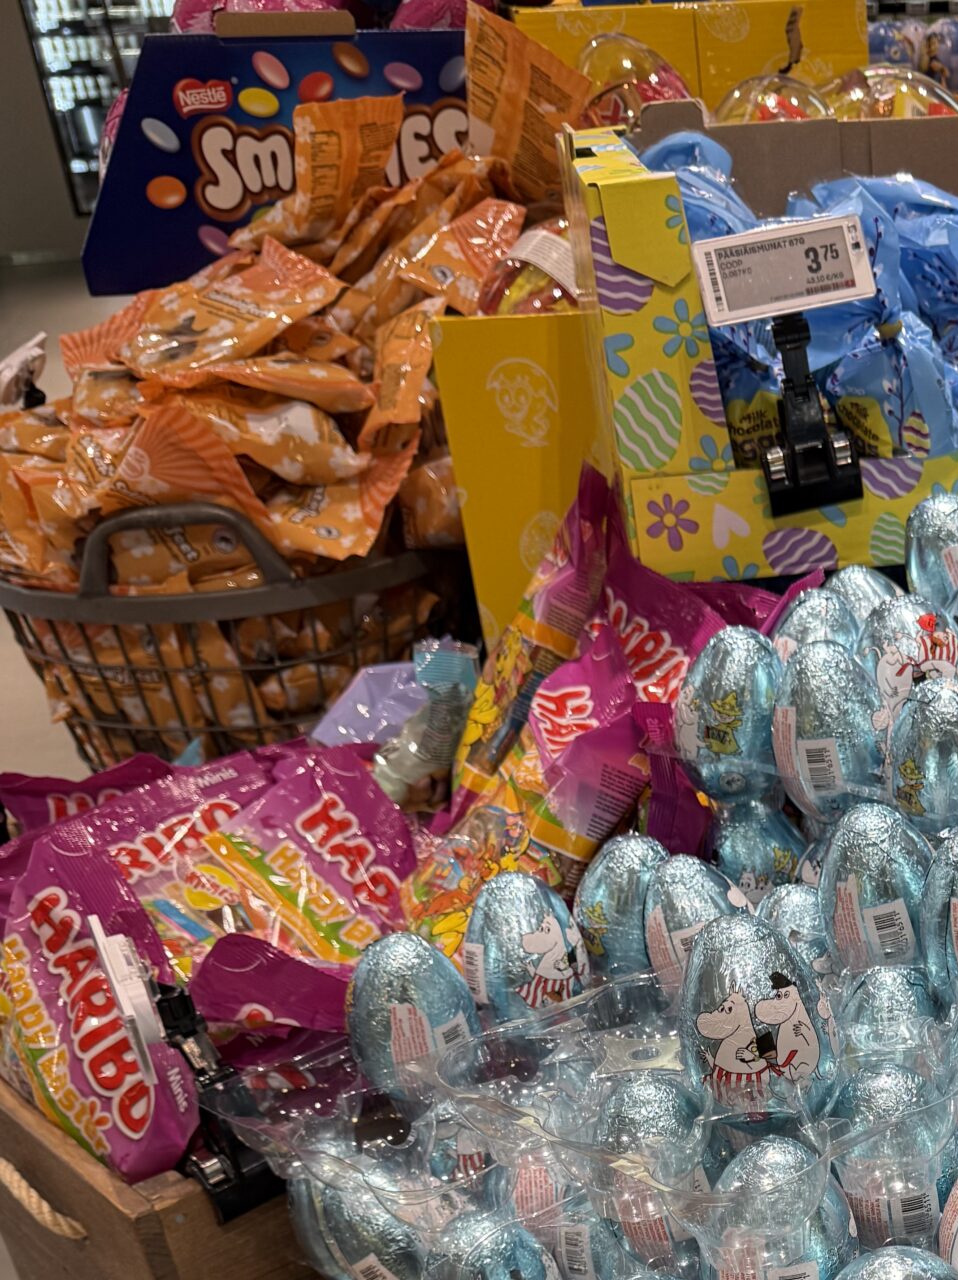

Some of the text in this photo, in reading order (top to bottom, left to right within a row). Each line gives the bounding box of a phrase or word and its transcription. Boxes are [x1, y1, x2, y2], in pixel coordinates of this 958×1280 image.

[720, 259, 743, 271] COOP
[804, 243, 840, 274] 3 75
[28, 886, 155, 1139] HARIBO
[166, 1065, 188, 1113] Minis
